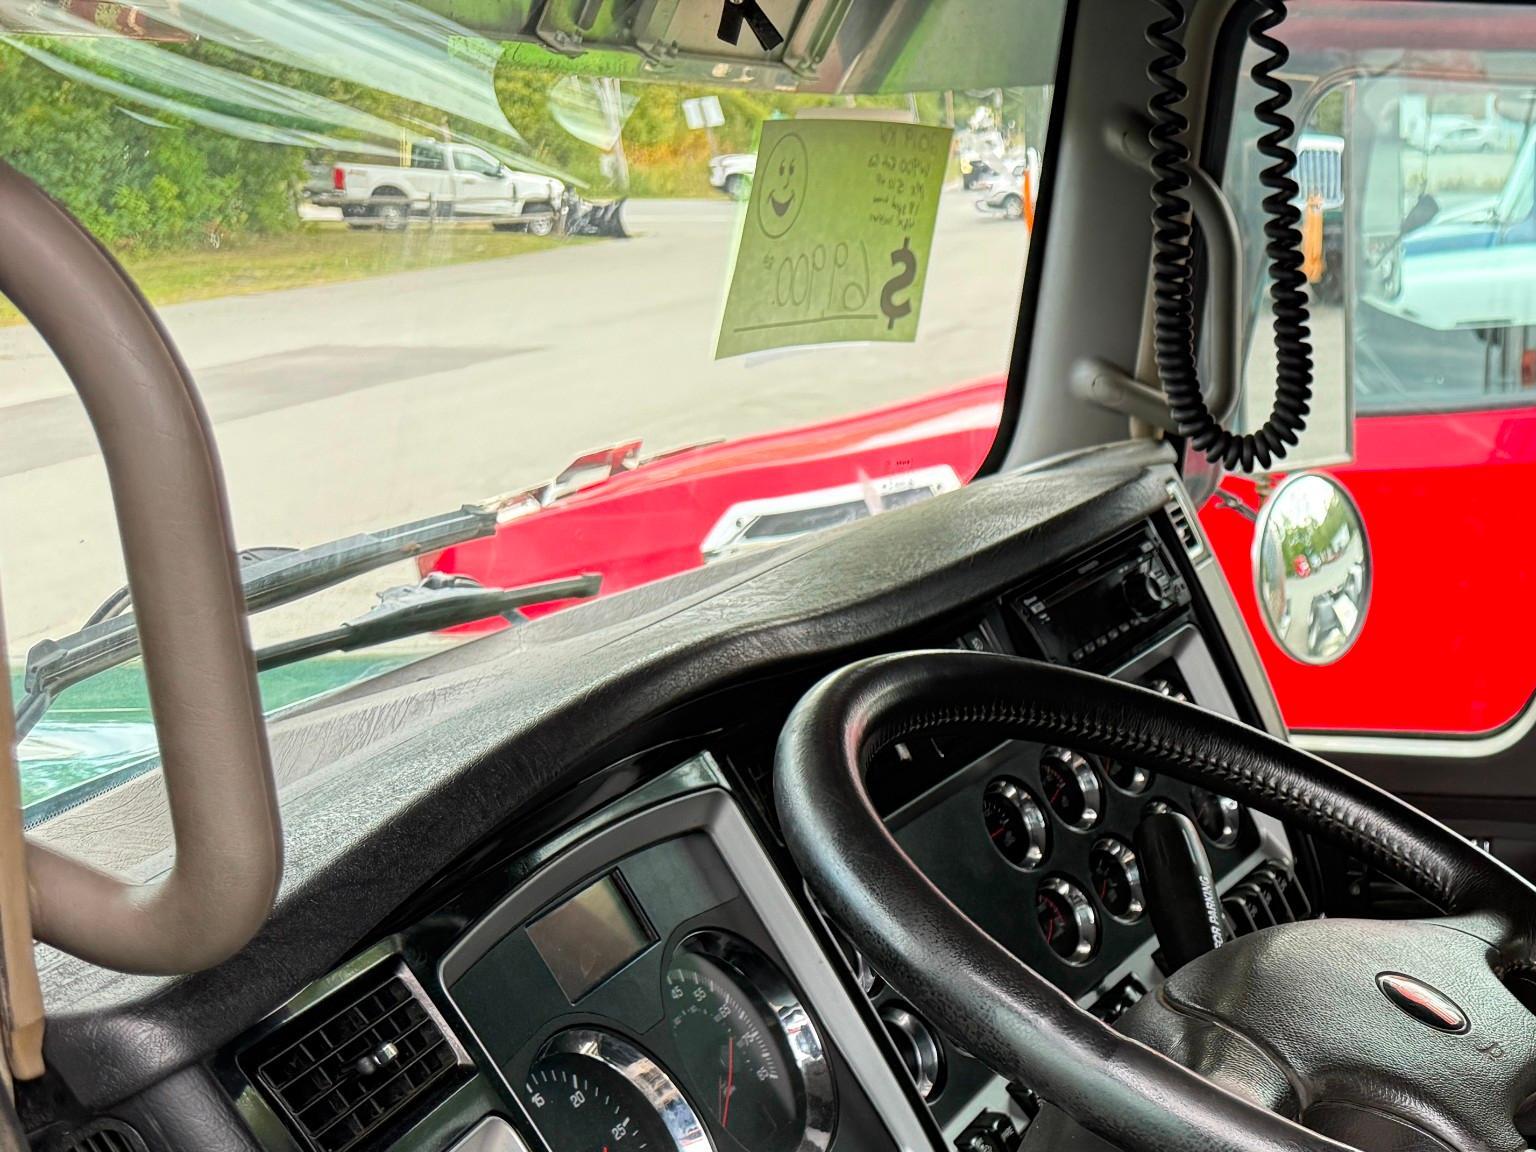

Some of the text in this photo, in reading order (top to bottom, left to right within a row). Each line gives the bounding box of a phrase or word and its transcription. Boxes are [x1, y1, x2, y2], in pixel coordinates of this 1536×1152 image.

[1199, 875, 1219, 925] PARKING
[531, 1093, 546, 1108] 15
[569, 1091, 586, 1108] 20
[611, 1123, 627, 1141] 25
